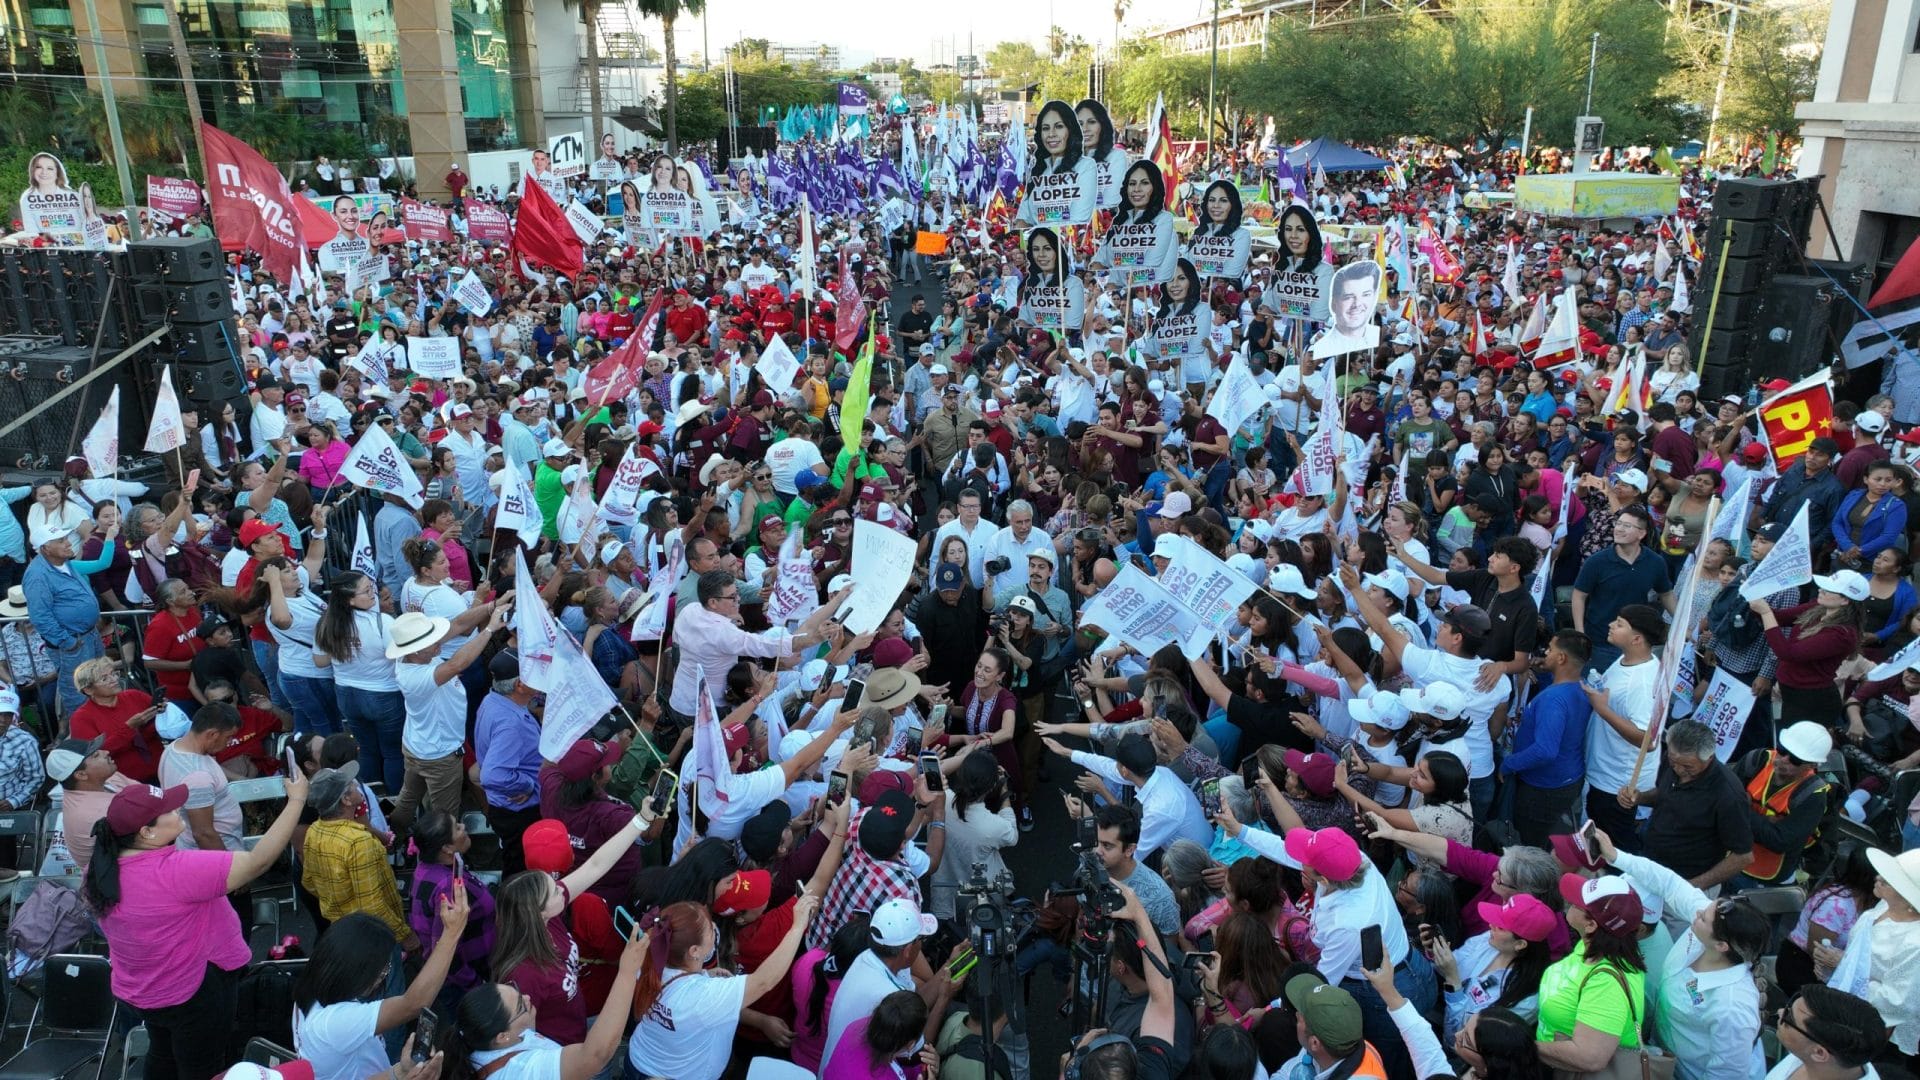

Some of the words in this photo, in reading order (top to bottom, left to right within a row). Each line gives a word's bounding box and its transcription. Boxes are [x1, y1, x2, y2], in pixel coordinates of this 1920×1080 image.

[552, 136, 583, 164] CTM
[1033, 173, 1079, 187] VICKY
[149, 184, 197, 195] CLAUDIA
[27, 193, 79, 203] GLORIA
[646, 192, 686, 201] GLORIA
[29, 201, 80, 210] CONTRERAS
[1037, 204, 1070, 213] morena
[39, 213, 73, 221] morena
[653, 210, 680, 218] morena
[570, 208, 599, 235] morena
[1114, 224, 1157, 235] VICKY
[331, 240, 366, 249] CLAUDIA
[1195, 235, 1236, 247] VICKY
[1195, 259, 1224, 267] morena
[1277, 271, 1319, 285] VICKY
[1029, 287, 1068, 297] VICKY
[1280, 299, 1309, 307] morena
[1158, 315, 1197, 327] VICKY
[1764, 399, 1816, 459] PT
[1712, 702, 1731, 738] ORTI
[1715, 705, 1738, 747] OSCAR
